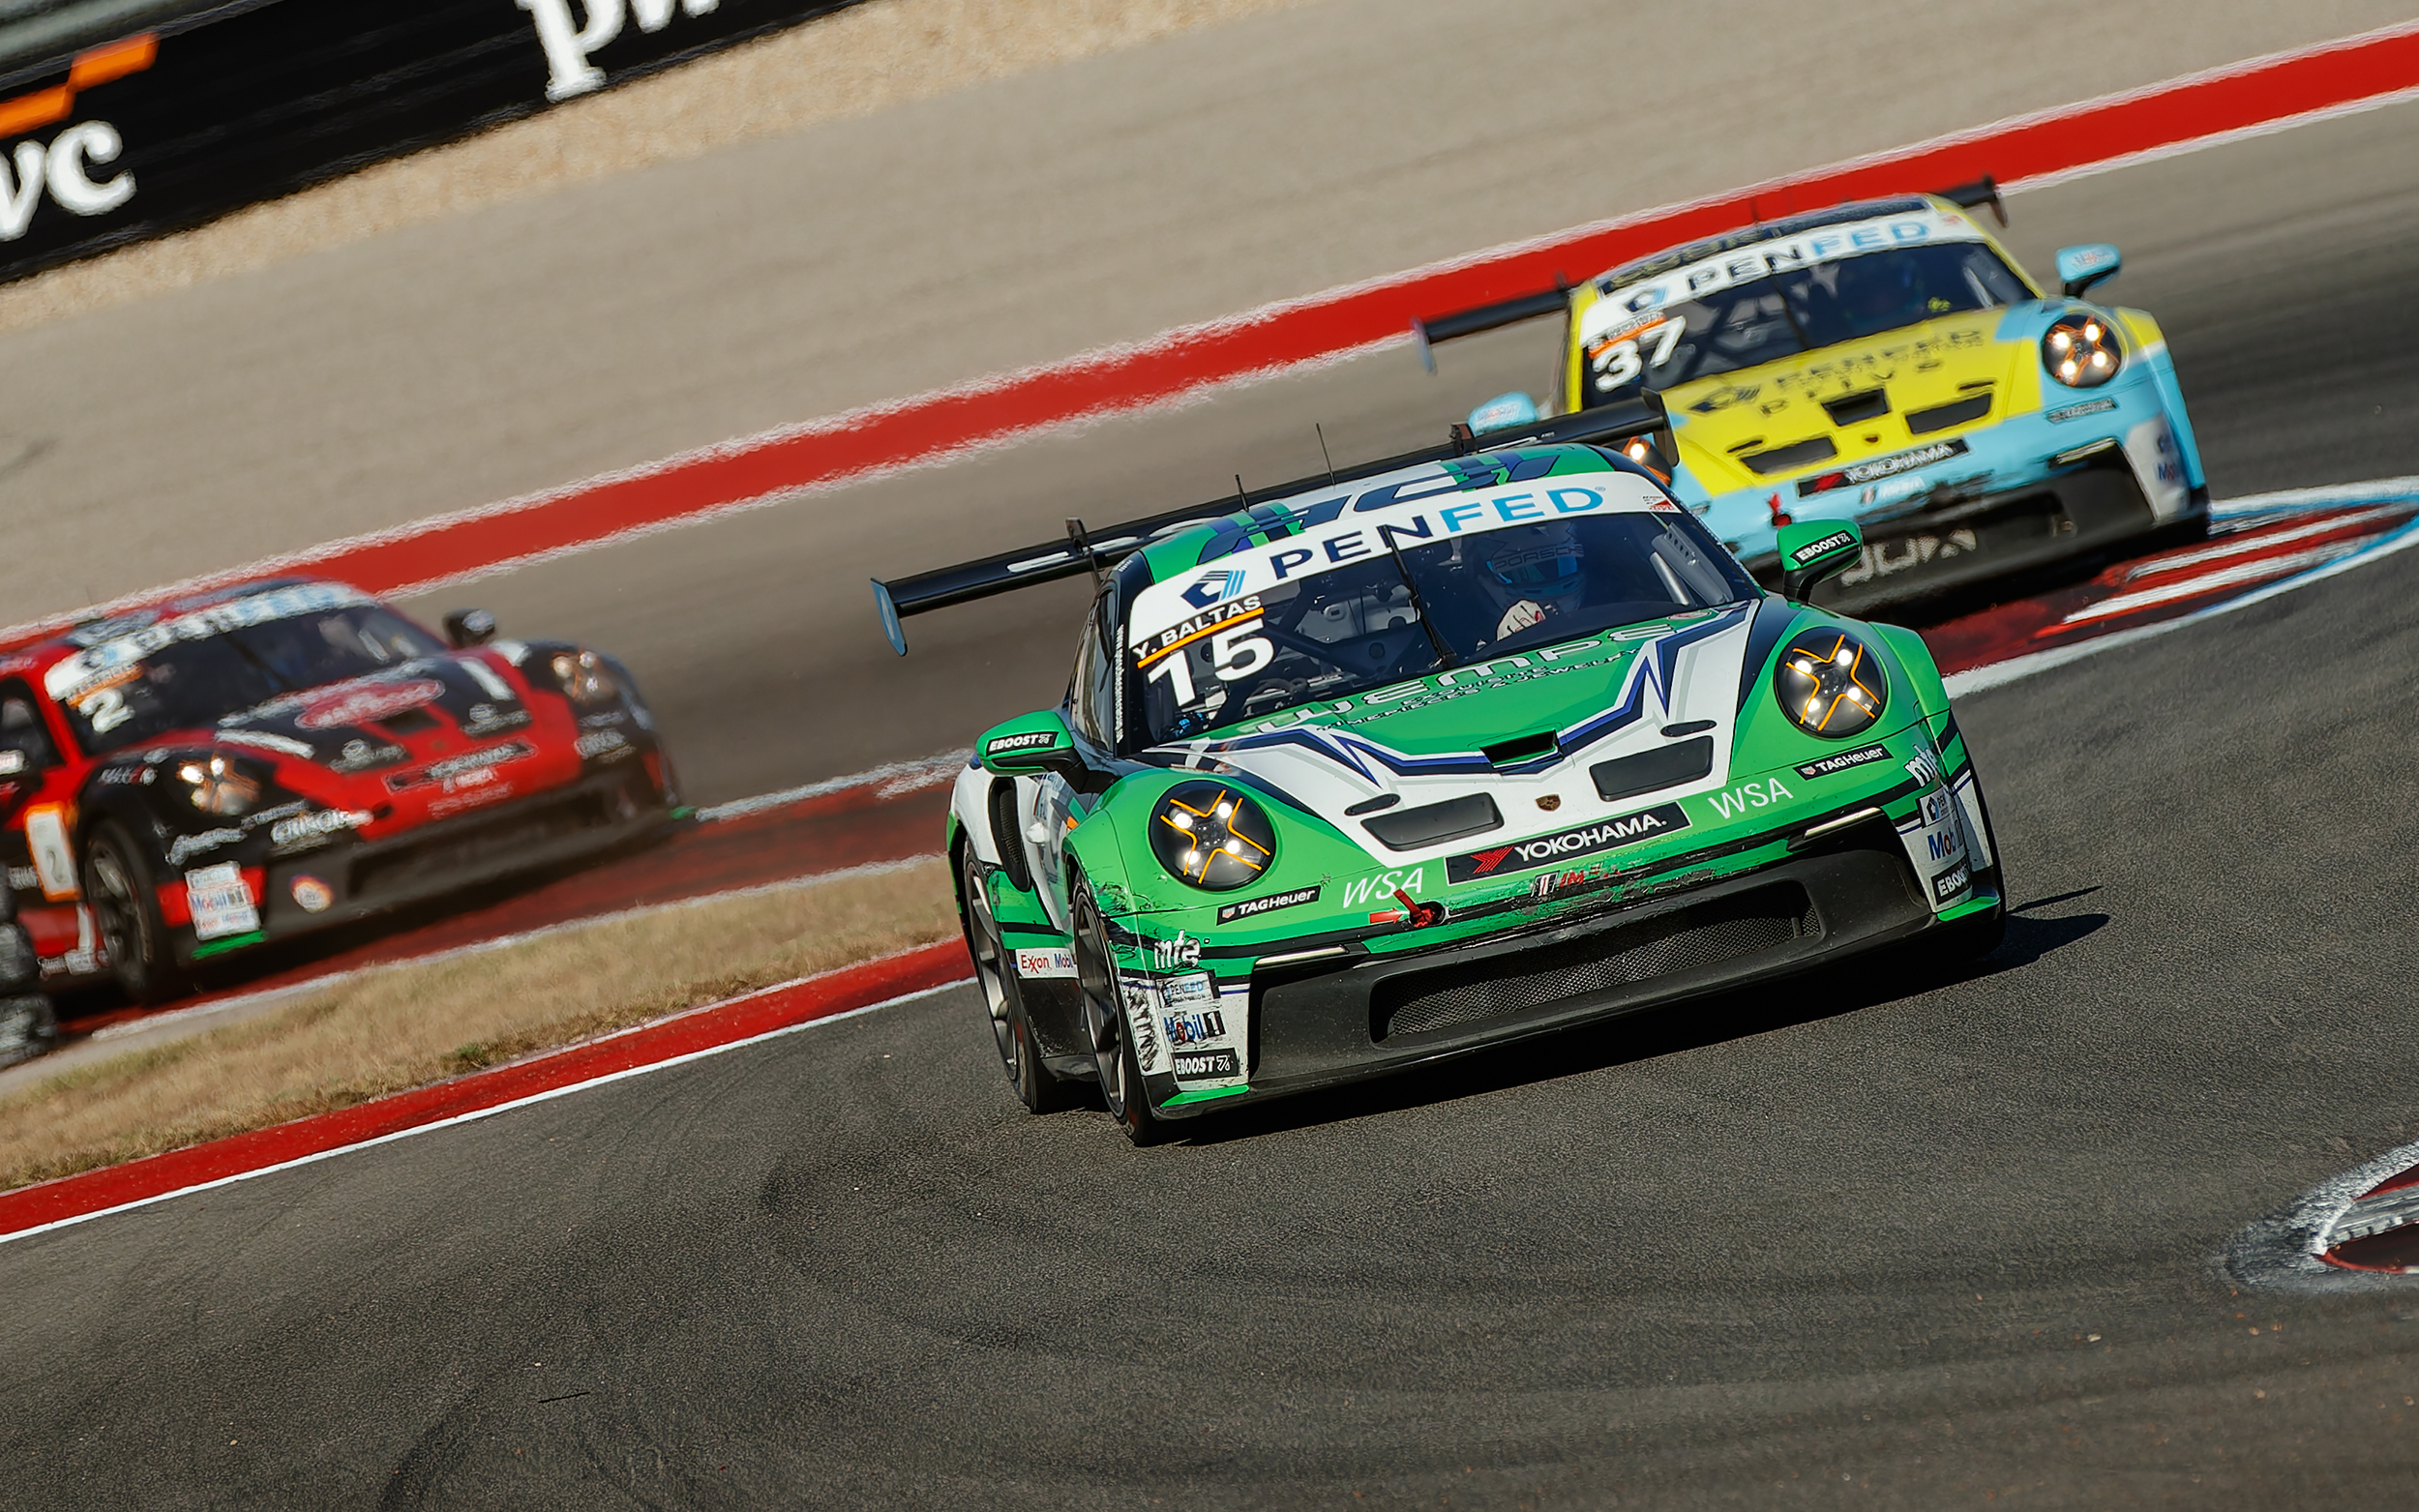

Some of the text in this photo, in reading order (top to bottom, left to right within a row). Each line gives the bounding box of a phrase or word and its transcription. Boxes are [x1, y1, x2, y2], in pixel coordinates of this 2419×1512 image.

[1686, 220, 1932, 290] PENFED
[1592, 314, 1687, 392] 37
[1844, 442, 1955, 485] YOKOHAMA
[1269, 487, 1604, 580] PENFED
[1796, 535, 1843, 561] EBOOST
[1161, 596, 1262, 647] BALTAS
[1147, 617, 1274, 707] 15
[78, 688, 135, 734] 2
[988, 734, 1039, 752] EBOOST
[1708, 777, 1794, 819] WSA
[1514, 814, 1662, 863] YOKOHAMA
[1342, 867, 1424, 908] WSA
[1021, 955, 1051, 974] Exxon
[1154, 930, 1201, 969] mte
[1163, 1013, 1208, 1043] Mobil
[1174, 1055, 1214, 1075] EBOOST
